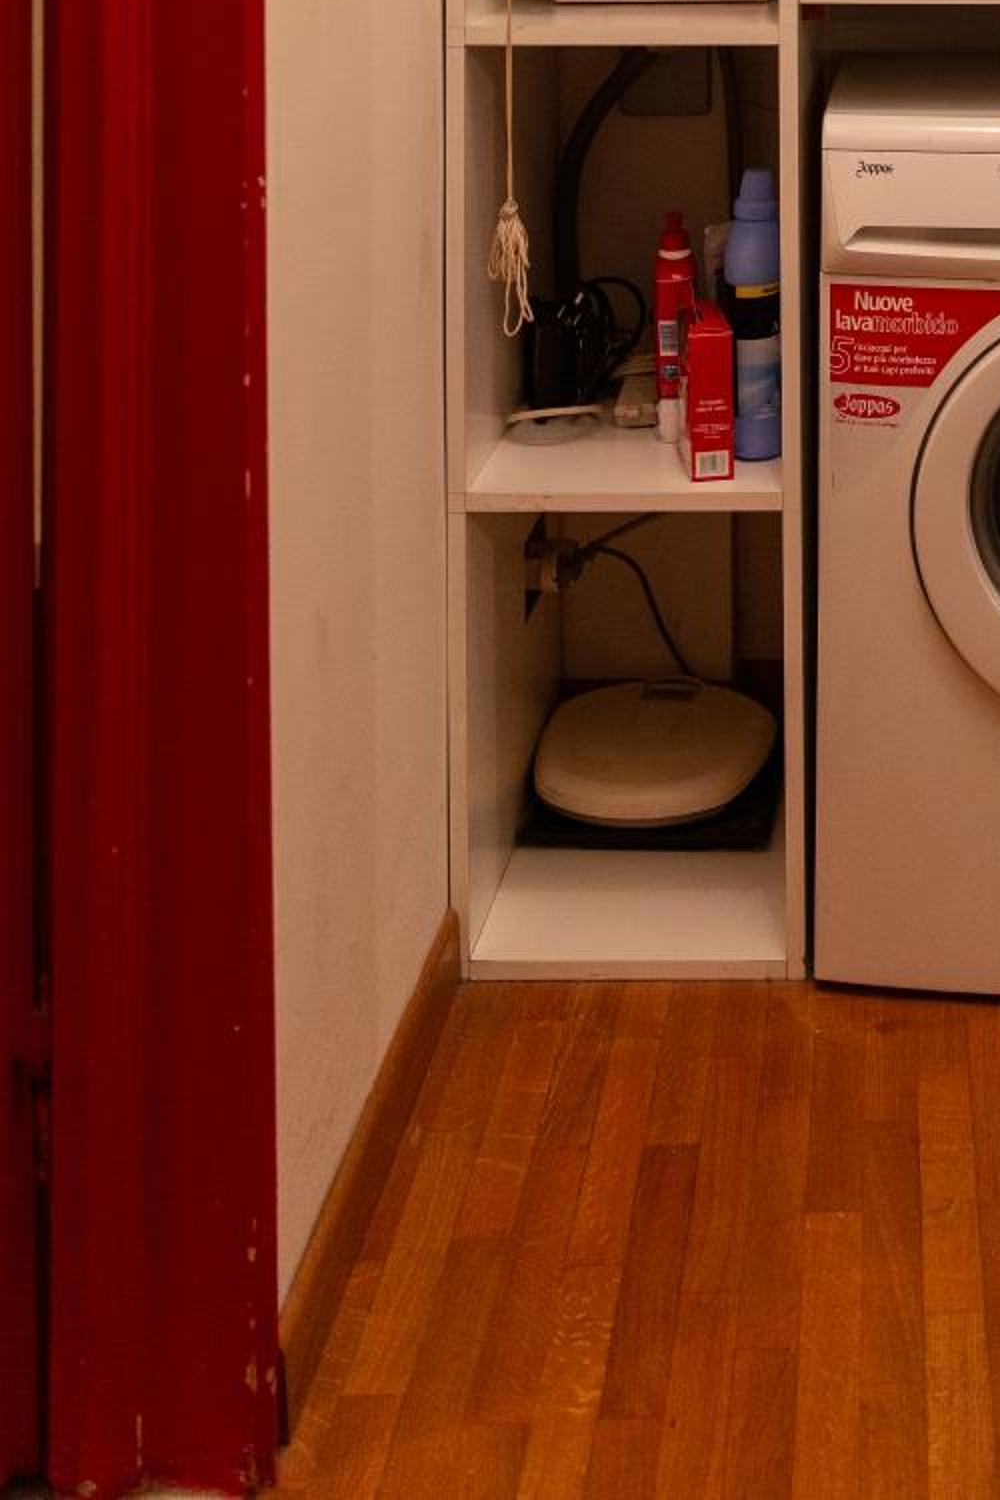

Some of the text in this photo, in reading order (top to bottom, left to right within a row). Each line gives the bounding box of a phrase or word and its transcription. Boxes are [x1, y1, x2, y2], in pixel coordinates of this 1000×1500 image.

[854, 291, 913, 312] Nuove
[835, 309, 959, 335] lavamorbido
[830, 335, 855, 375] 5
